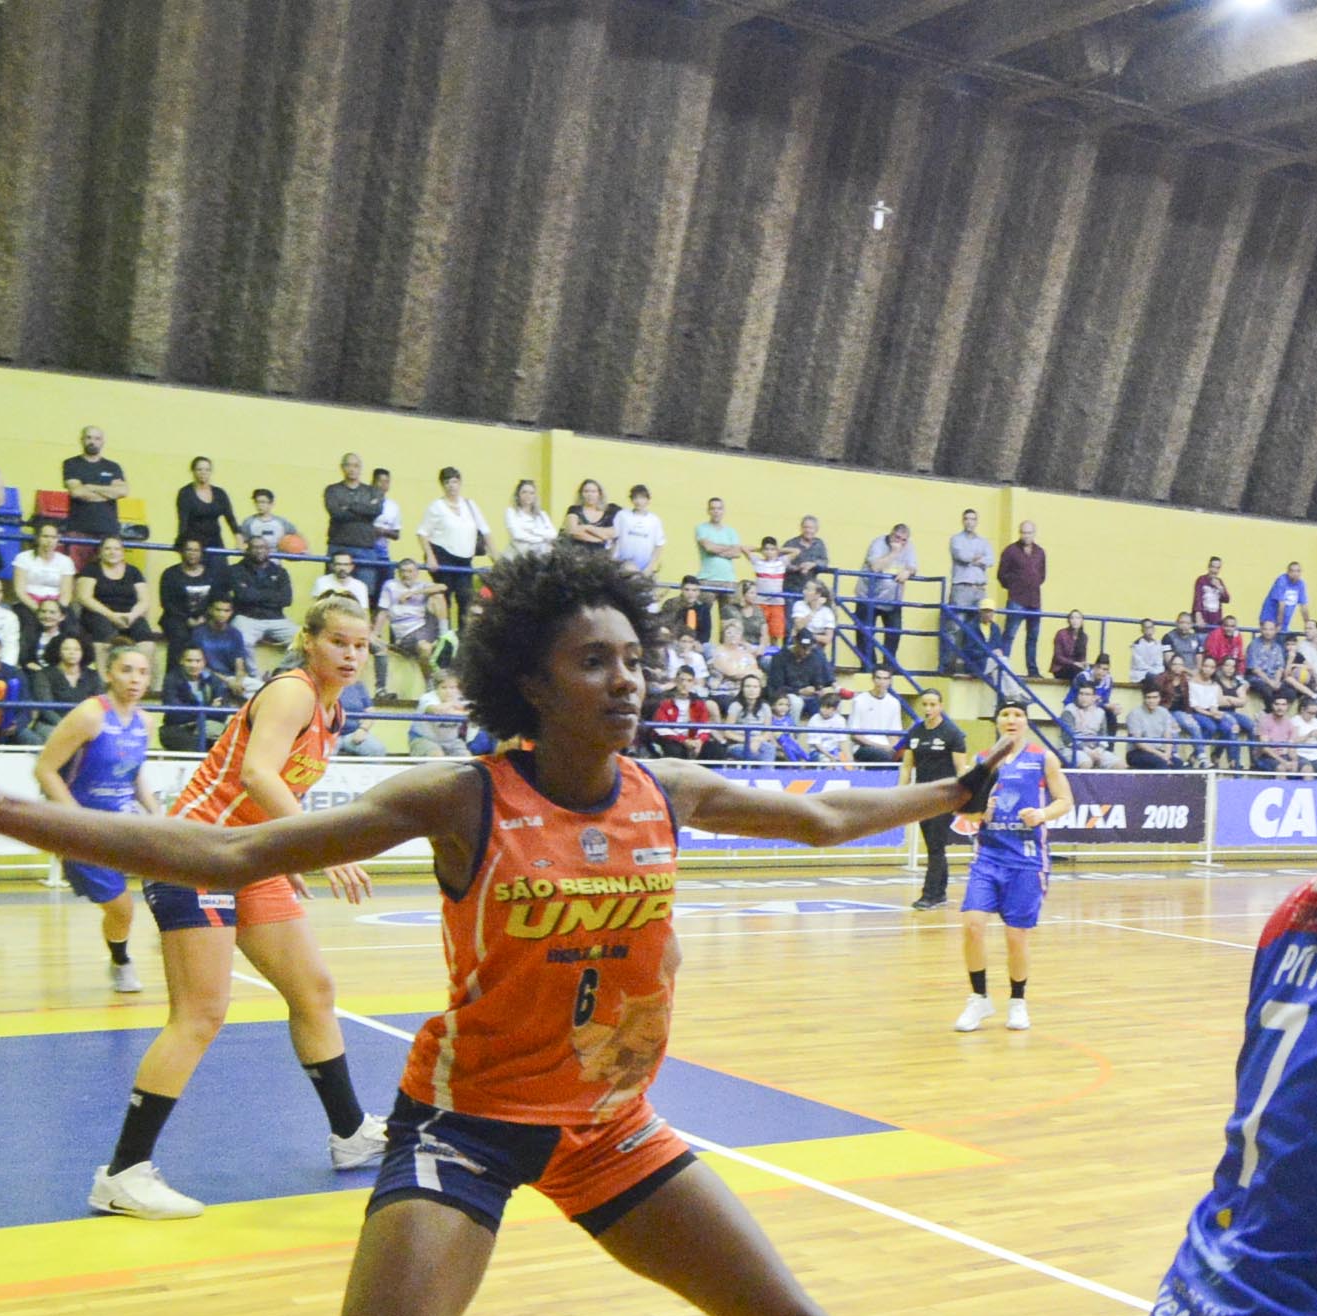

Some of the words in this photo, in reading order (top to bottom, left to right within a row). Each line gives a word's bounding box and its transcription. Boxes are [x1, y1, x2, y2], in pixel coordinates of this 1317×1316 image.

[1141, 805, 1190, 830] 2018
[494, 875, 555, 901] SÃO
[505, 895, 675, 939] UNIP
[573, 967, 600, 1029] 6
[1238, 1000, 1310, 1188] 7
